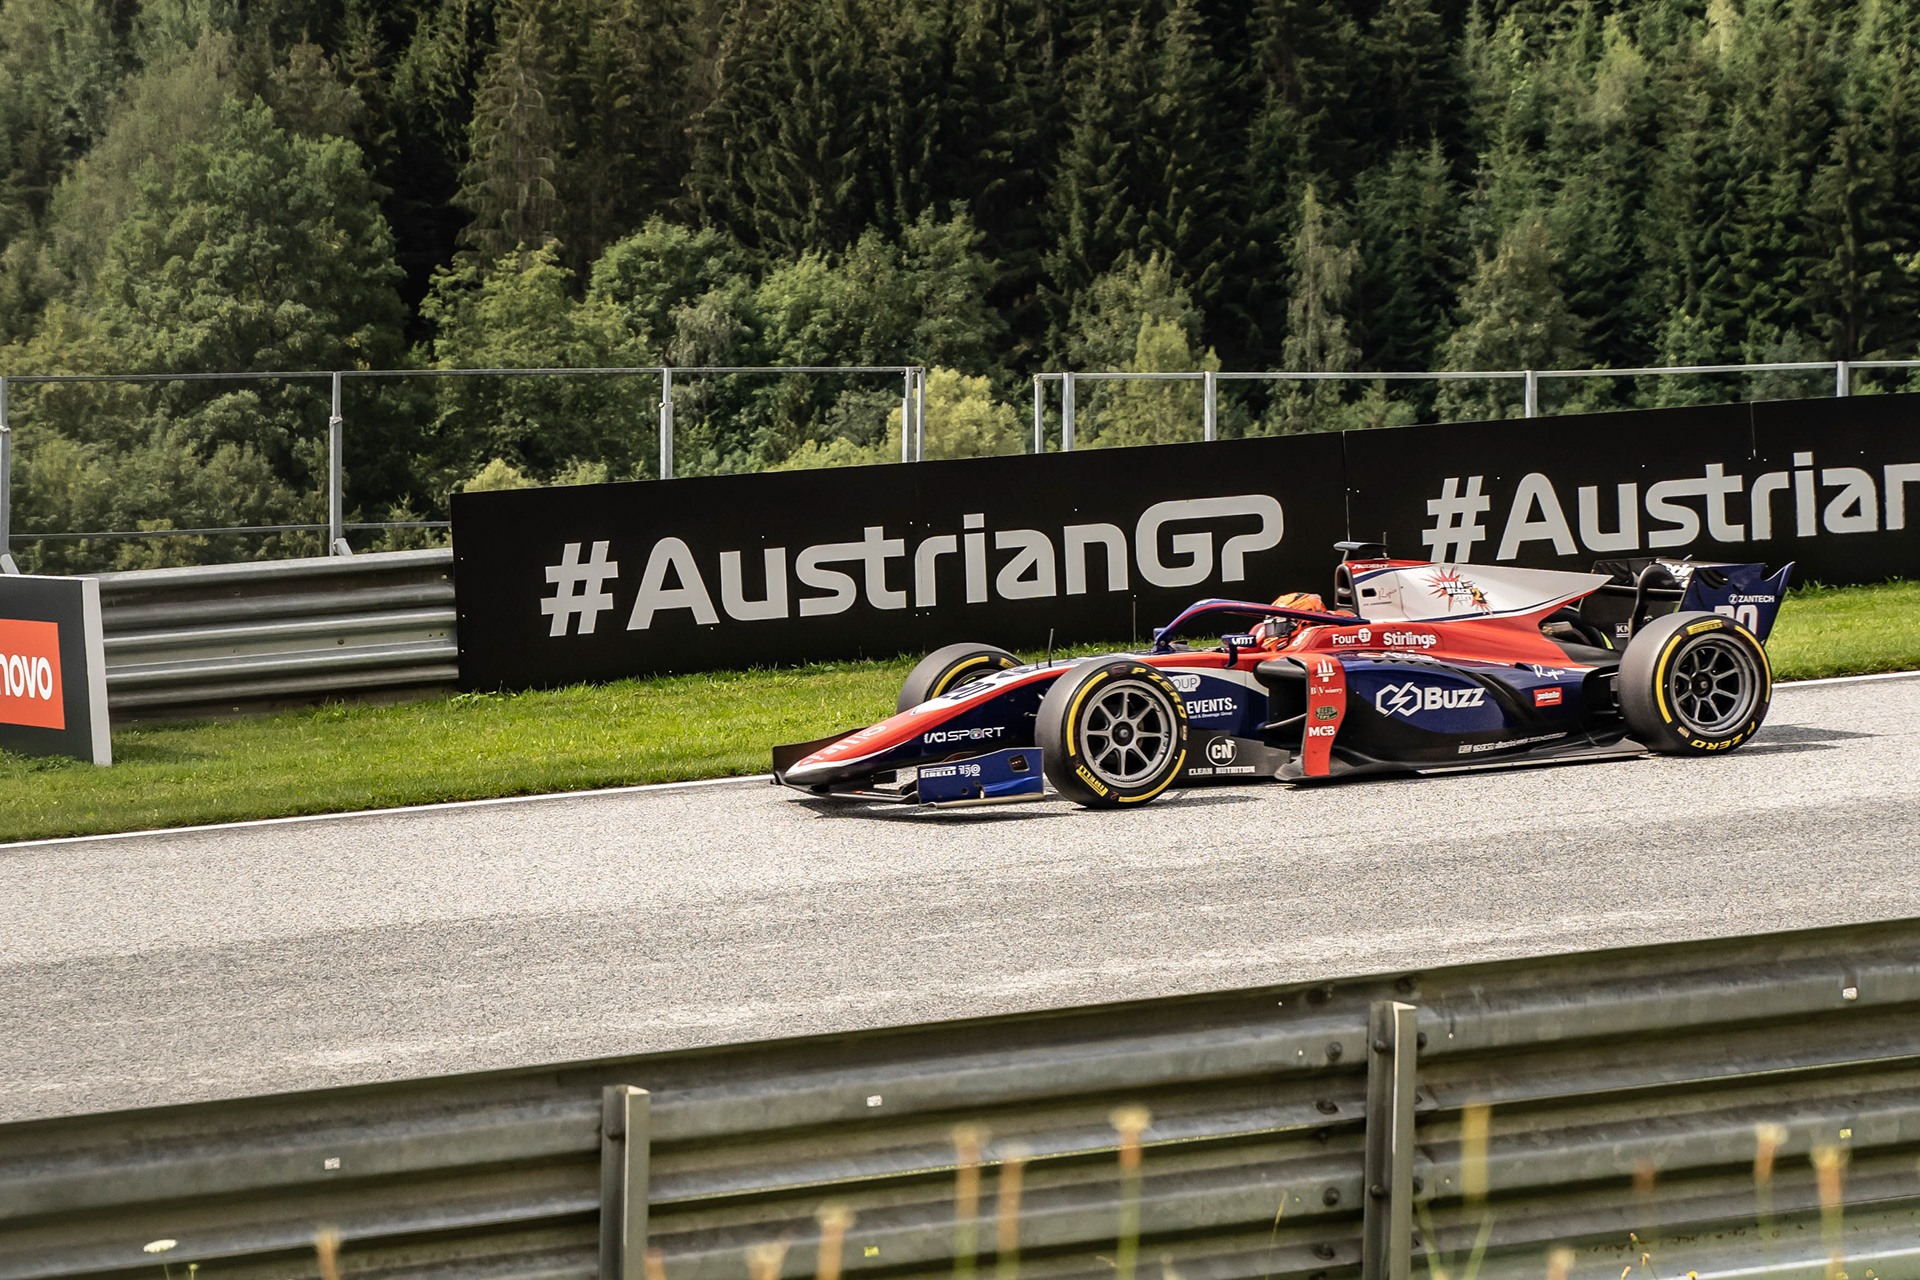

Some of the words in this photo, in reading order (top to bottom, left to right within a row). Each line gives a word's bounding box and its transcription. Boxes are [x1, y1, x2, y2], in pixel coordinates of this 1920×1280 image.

[540, 494, 1283, 637] #AustrianGP
[1738, 595, 1775, 603] ZANTECH
[1332, 633, 1358, 645] Four
[1382, 631, 1437, 649] Stirlings
[1308, 726, 1335, 737] MCB
[920, 766, 957, 779] PIRELLI
[1188, 767, 1213, 776] CLEAN
